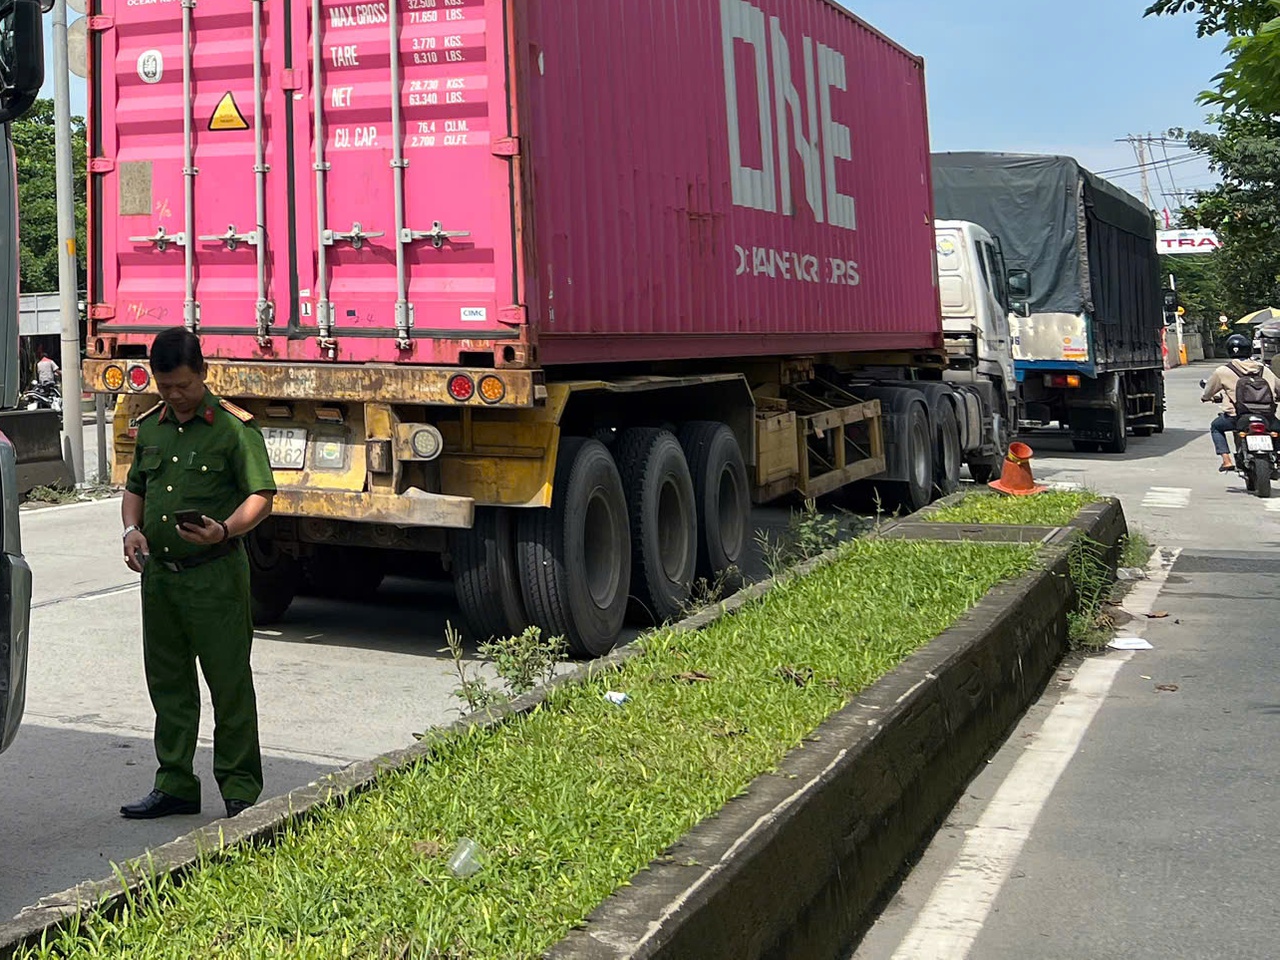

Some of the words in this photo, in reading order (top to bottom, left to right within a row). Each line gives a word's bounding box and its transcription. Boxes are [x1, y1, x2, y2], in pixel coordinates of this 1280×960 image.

[409, 11, 438, 23] 71.650
[445, 8, 465, 20] LBS.
[330, 45, 359, 67] TARE
[412, 37, 436, 50] 3.770
[444, 35, 463, 47] KGS.
[413, 52, 438, 64] 8.310
[445, 50, 465, 62] LBS.
[331, 87, 353, 108] NET
[409, 92, 438, 106] 63.340
[446, 91, 465, 103] LBS.
[334, 128, 351, 148] CU.
[354, 126, 379, 146] CAP.
[417, 121, 435, 134] 76.4
[462, 309, 485, 317] CIMC
[268, 430, 294, 446] 51R
